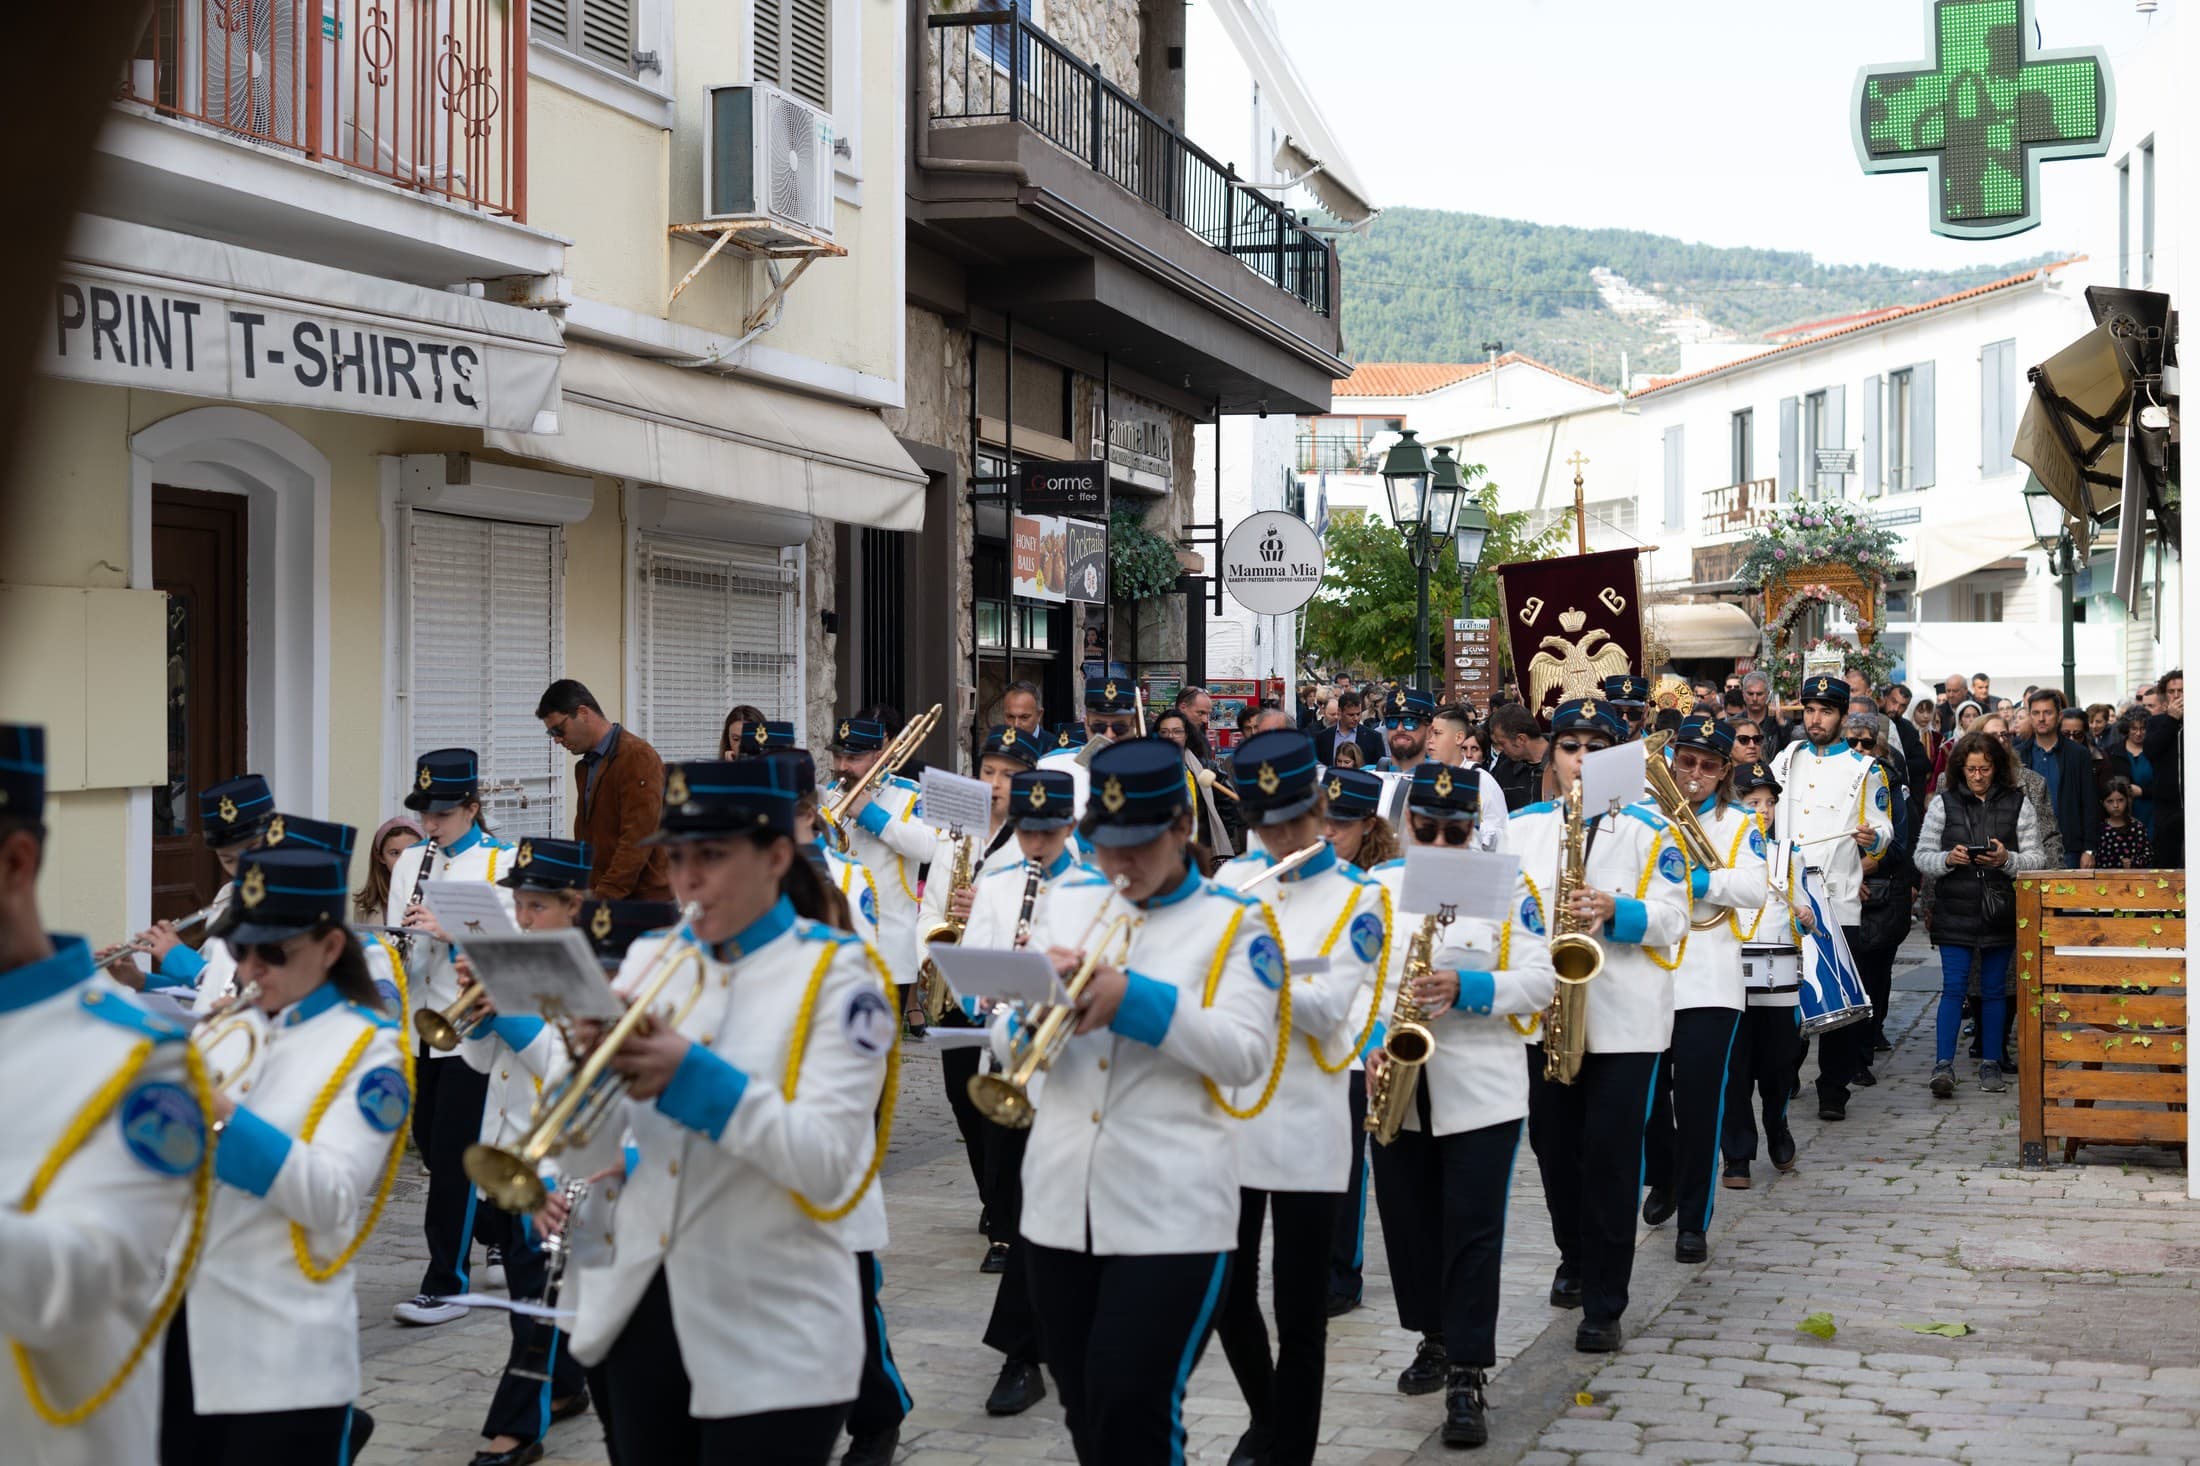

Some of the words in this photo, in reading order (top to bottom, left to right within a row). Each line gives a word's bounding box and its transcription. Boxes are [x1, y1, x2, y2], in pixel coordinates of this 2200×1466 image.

[57, 284, 201, 372] PRINT
[230, 311, 479, 408] T-SHIRTS
[1143, 421, 1170, 461] Mia
[1016, 533, 1037, 552] HONEY
[1069, 528, 1104, 566] Cocktails
[1017, 555, 1035, 572] BALLS
[1229, 564, 1285, 577] Mamma
[1290, 563, 1317, 576] Mia
